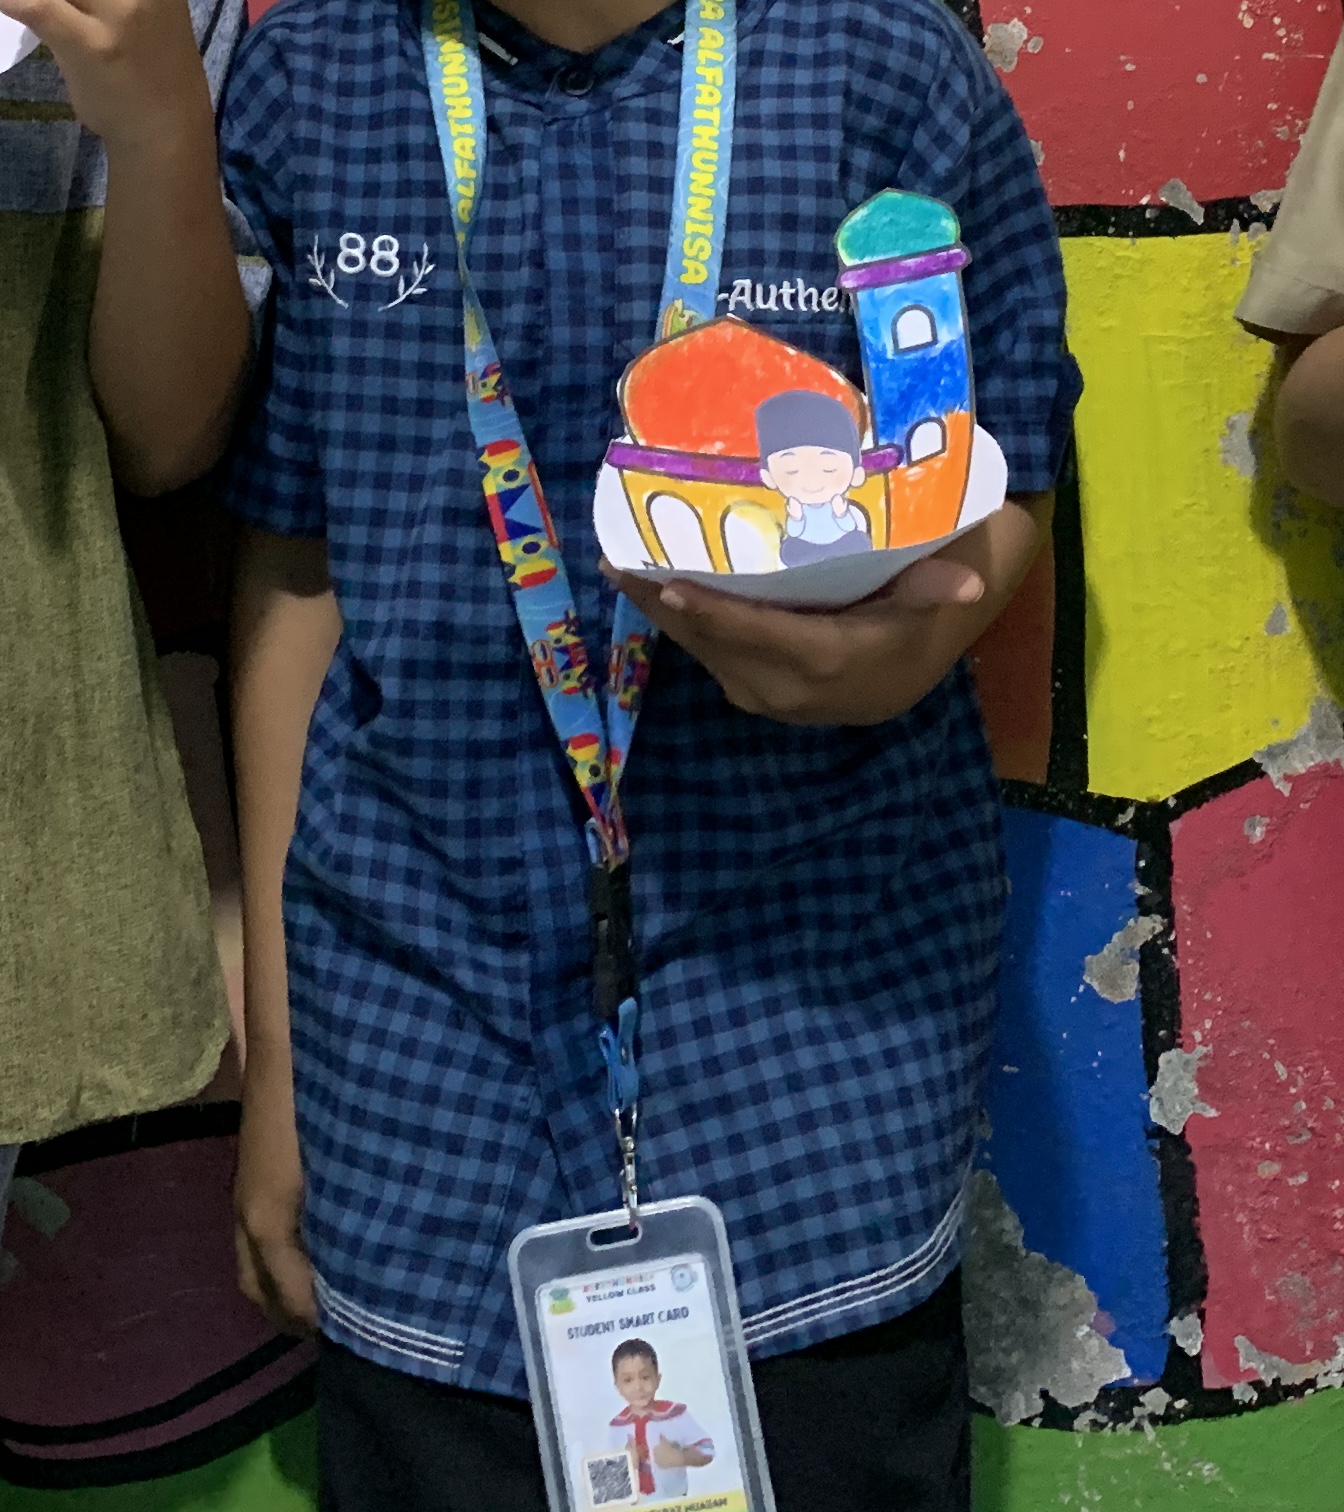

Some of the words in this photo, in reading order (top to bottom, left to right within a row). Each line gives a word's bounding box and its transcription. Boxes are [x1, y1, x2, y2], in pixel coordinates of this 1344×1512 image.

[680, 26, 725, 285] ALFATHUNNISA
[337, 232, 400, 277] 88
[586, 1289, 624, 1303] YELLOW
[626, 1283, 656, 1296] CLASS
[567, 1320, 615, 1340] STUDENT
[618, 1312, 655, 1330] SMART
[657, 1306, 690, 1323] CARD
